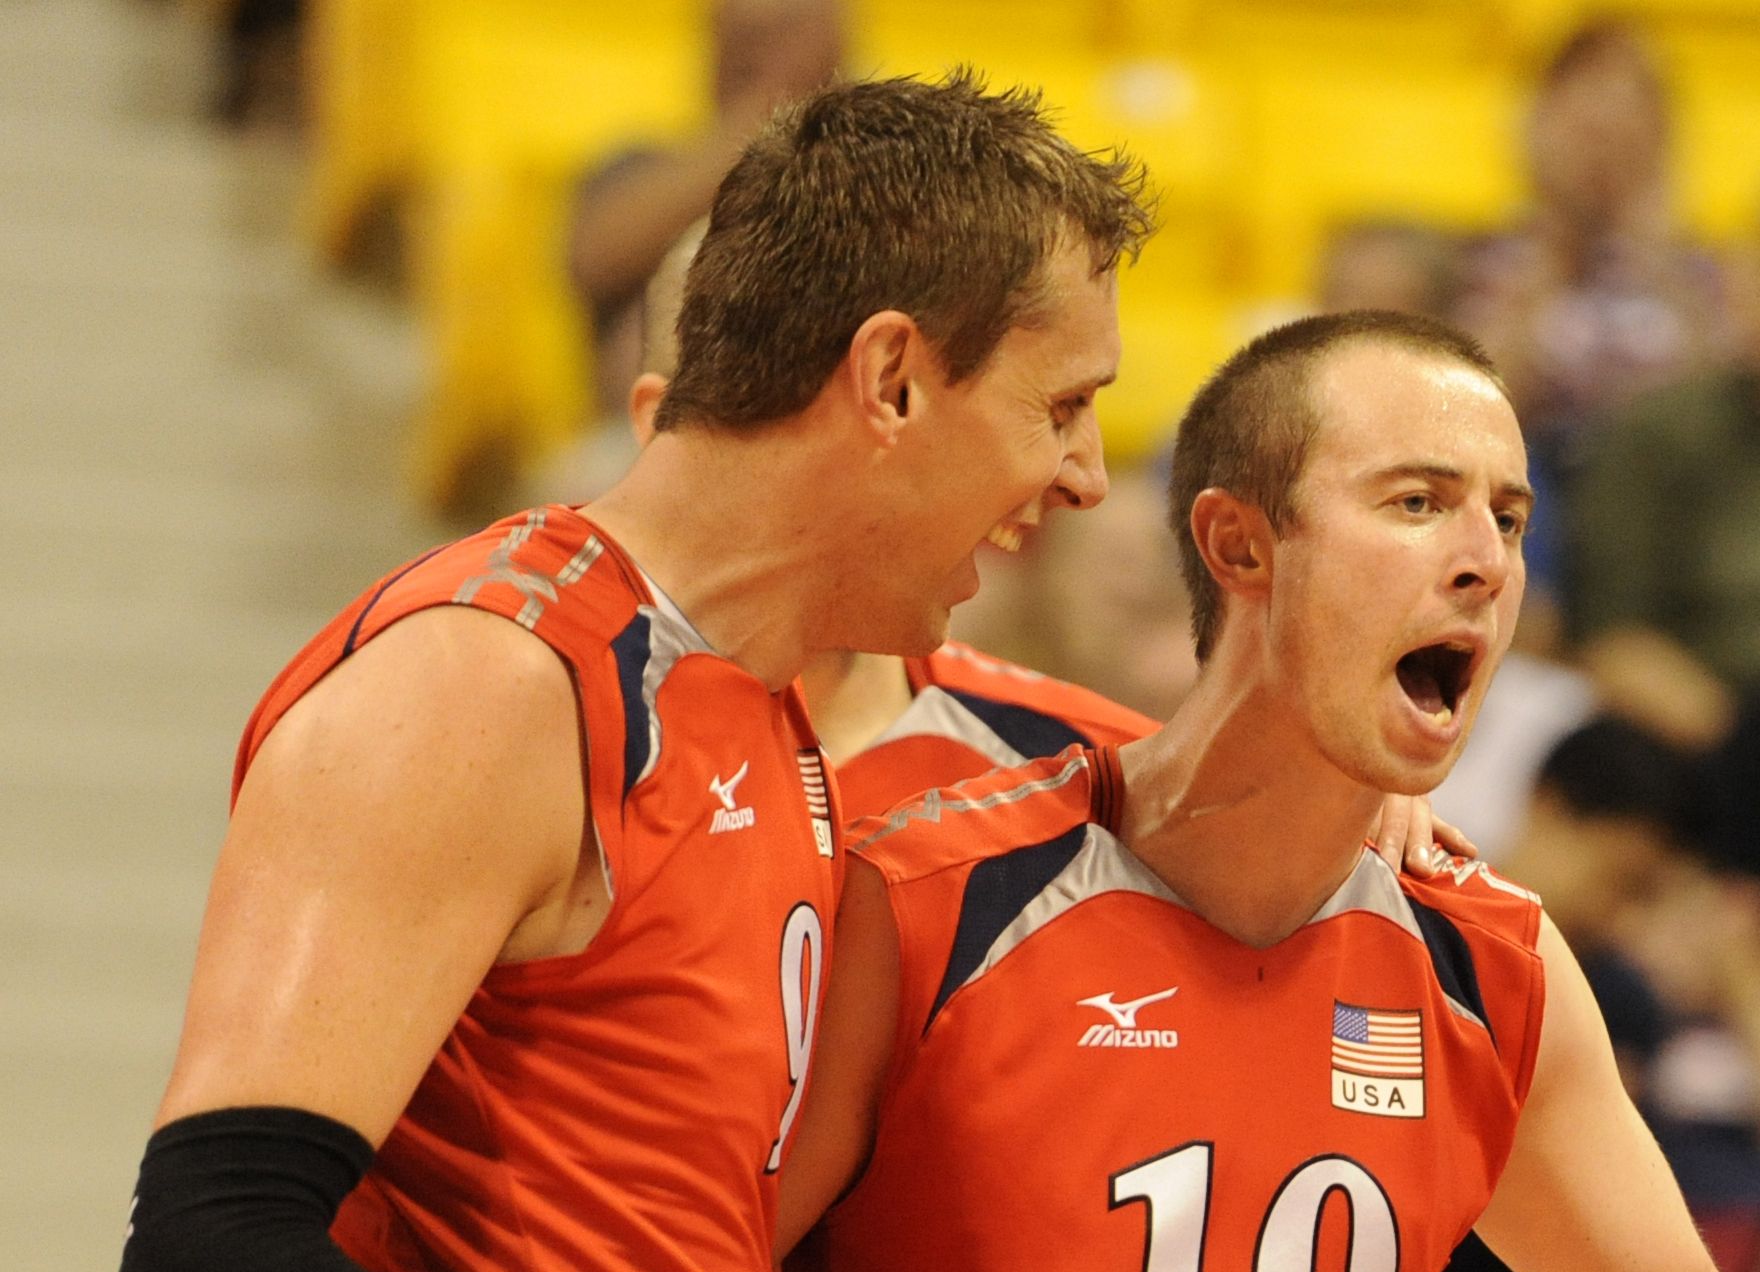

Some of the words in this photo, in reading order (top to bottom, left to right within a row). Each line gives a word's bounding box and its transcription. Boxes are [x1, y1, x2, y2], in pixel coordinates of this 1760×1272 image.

[763, 900, 823, 1175] 9
[1077, 1023, 1179, 1049] MIZUNO
[1342, 1079, 1406, 1110] USA
